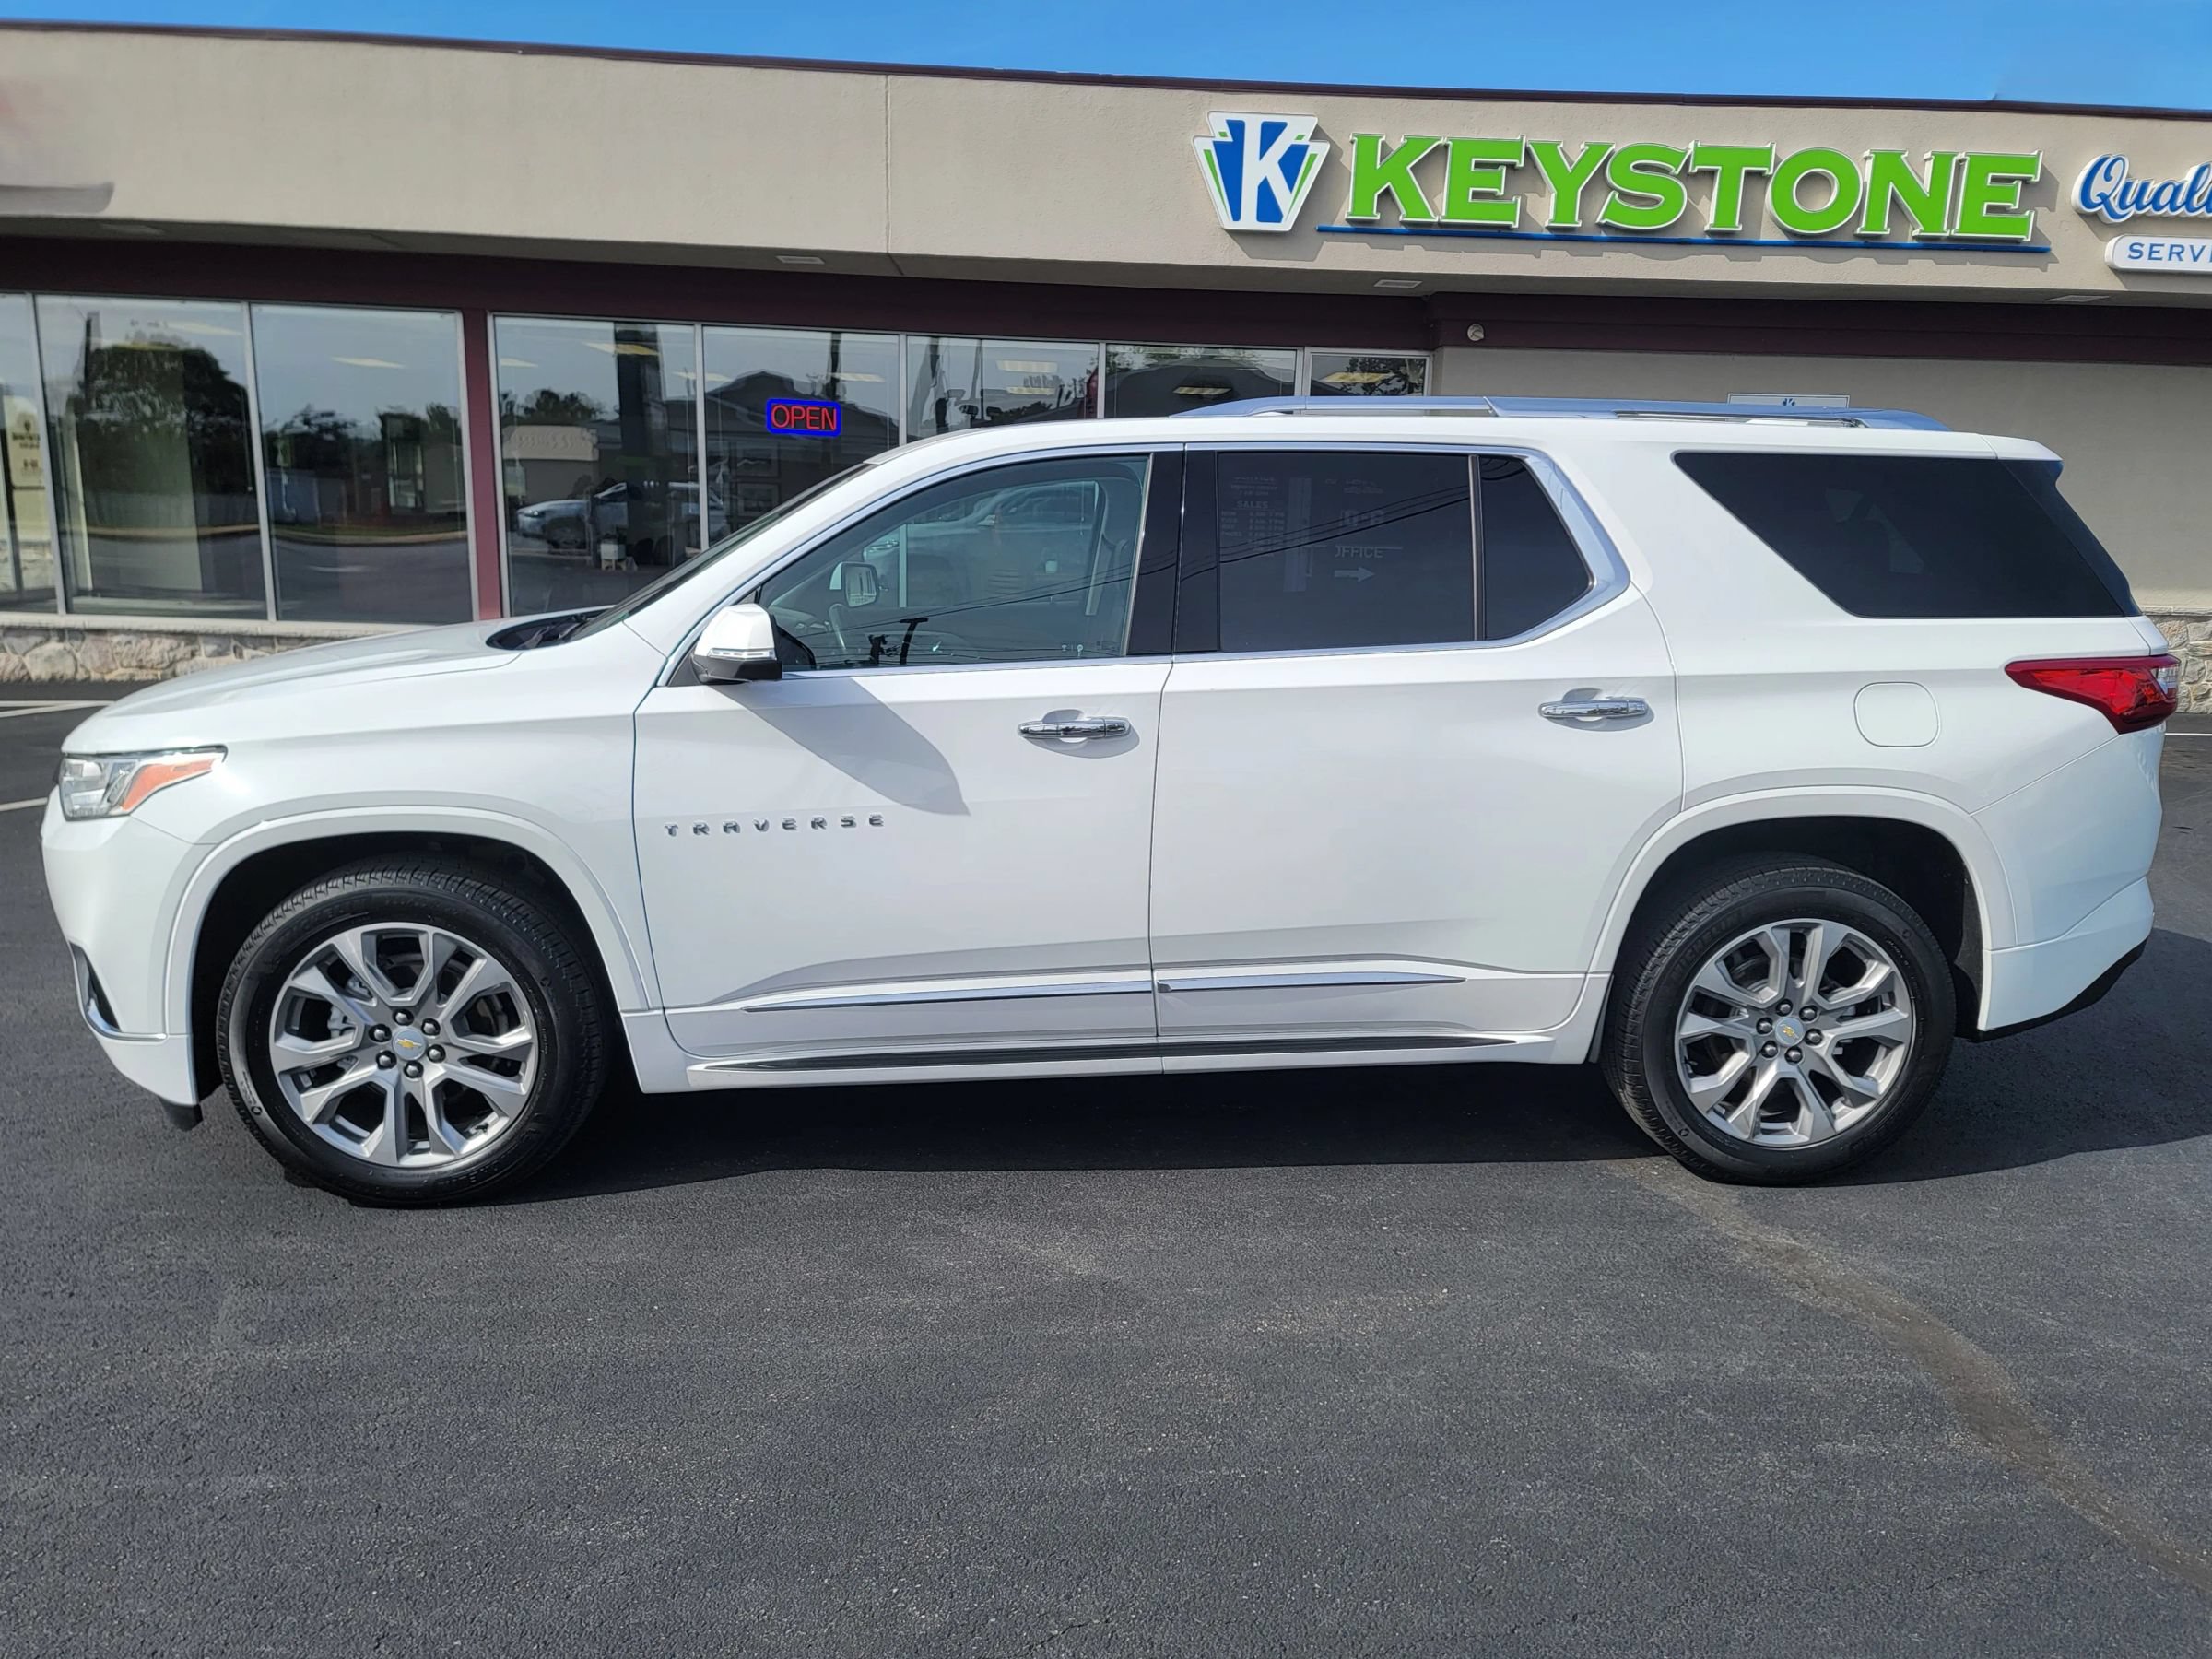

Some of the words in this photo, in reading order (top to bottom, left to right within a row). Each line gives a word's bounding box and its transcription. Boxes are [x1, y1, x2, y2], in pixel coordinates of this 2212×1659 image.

[1239, 117, 1295, 226] K
[1345, 133, 2043, 241] KEYSTONE
[771, 404, 838, 431] OPEN
[665, 813, 885, 837] TRAVERSE
